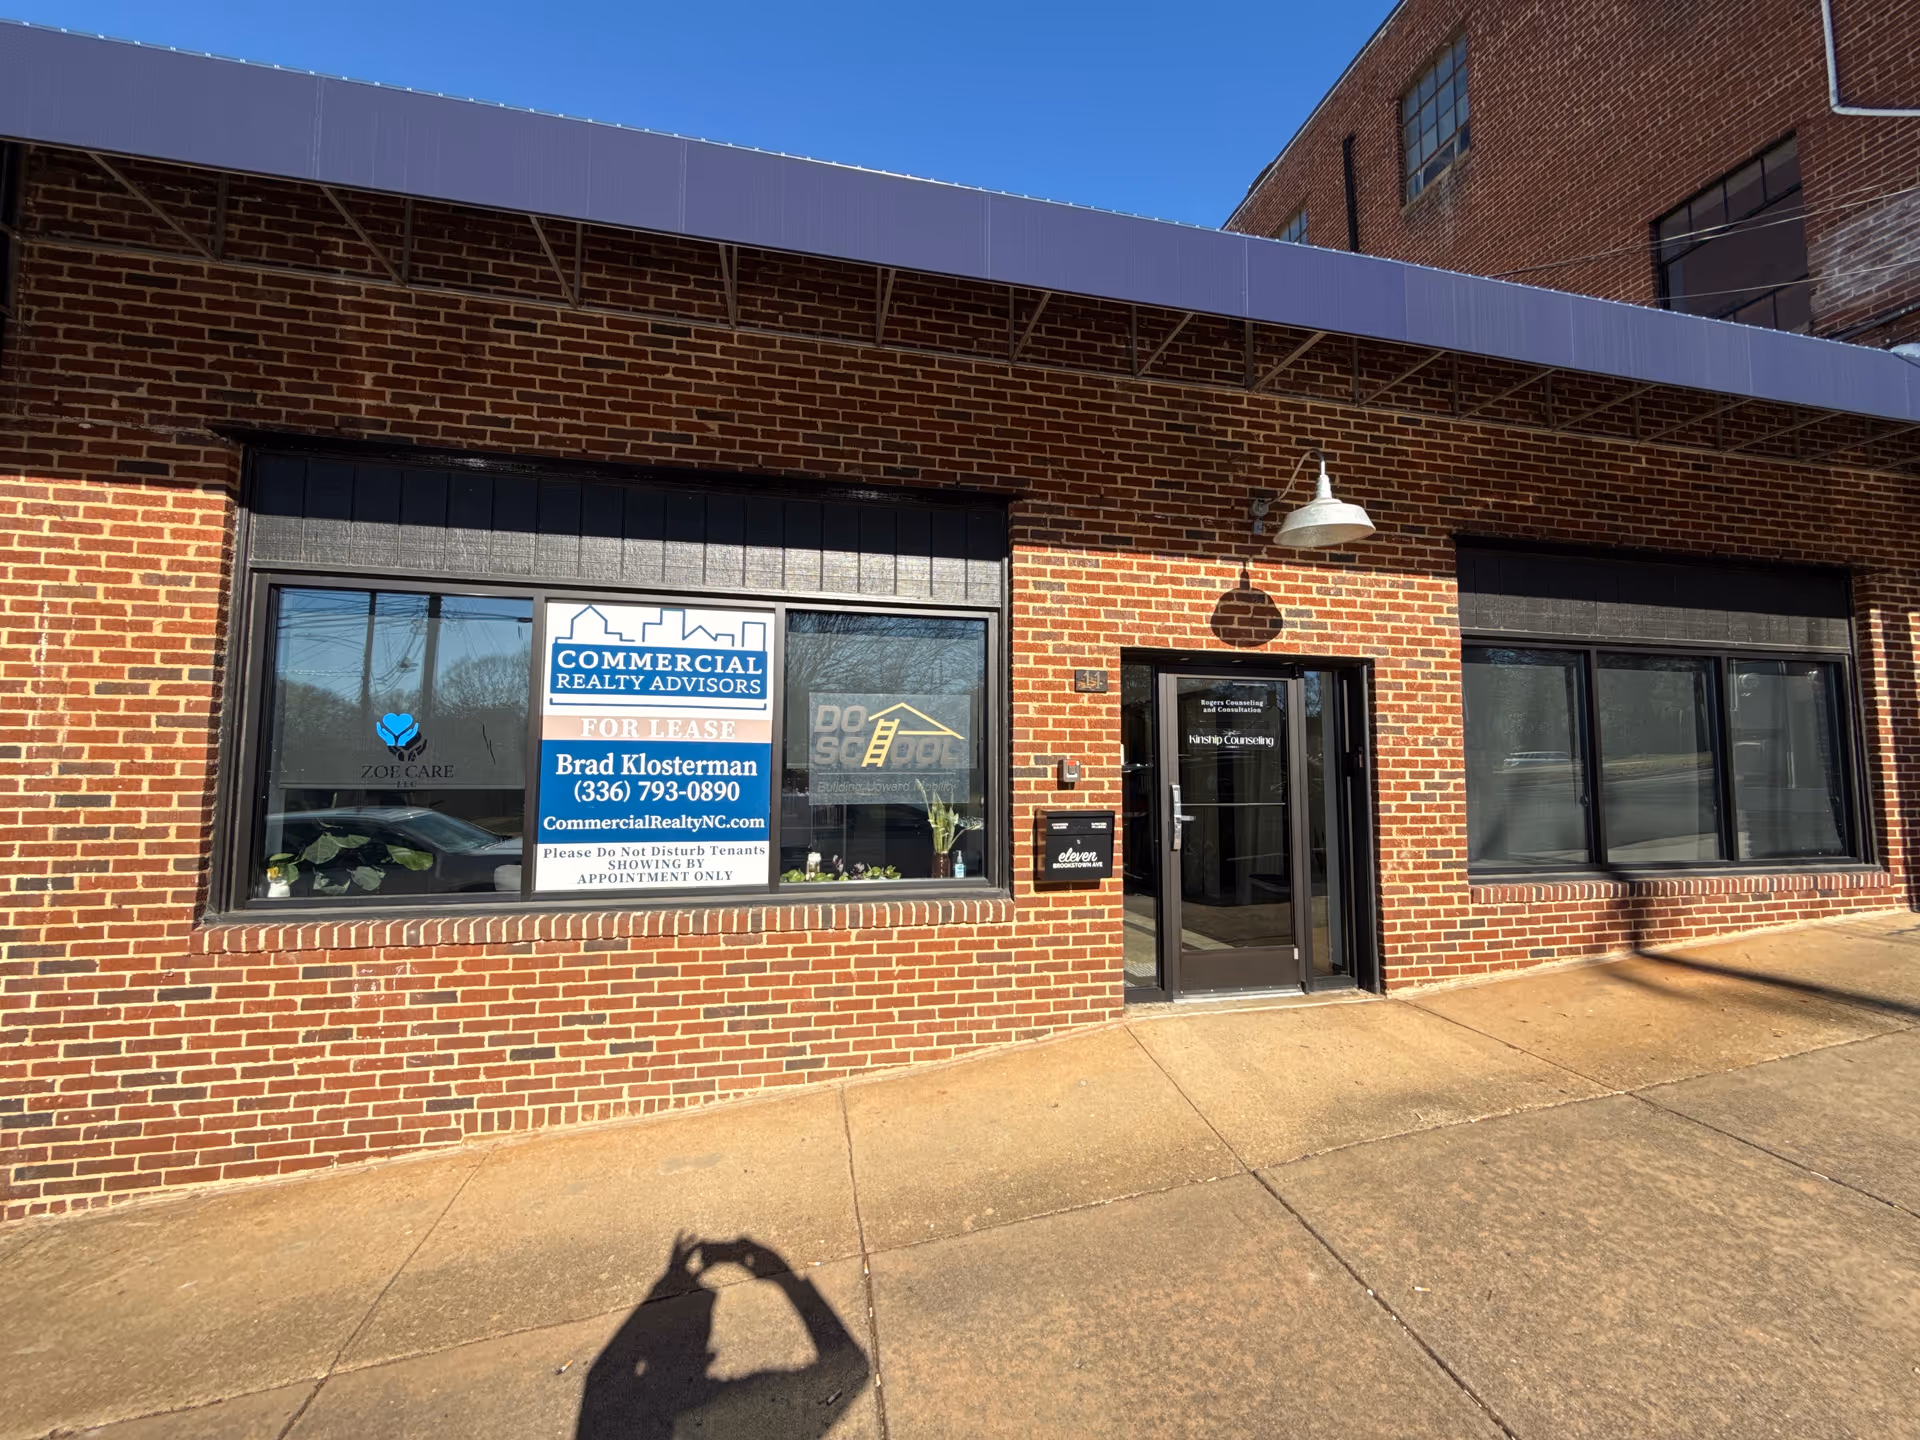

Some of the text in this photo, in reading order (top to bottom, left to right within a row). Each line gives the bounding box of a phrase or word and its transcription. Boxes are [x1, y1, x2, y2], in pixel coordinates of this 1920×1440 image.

[557, 650, 763, 675] COMMERCIAL
[556, 673, 761, 694] REALTY ADVISORS
[1083, 670, 1101, 689] 11
[1200, 699, 1224, 707] Rogers
[580, 718, 737, 739] FOR LEASE
[814, 705, 868, 733] DO
[1188, 734, 1274, 748] Kinship Counseling
[360, 765, 455, 779] ZOE CARE
[556, 752, 758, 777] Brad Klosterman
[573, 780, 740, 803] (336) 793-0890
[543, 814, 765, 833] CommercialRealtyNC.com
[543, 845, 765, 858] Please Do Not Disturb Tenants
[1058, 847, 1098, 863] eleven
[608, 858, 705, 870] SHOWING BY
[577, 870, 733, 884] APPOINTMENT ONLY
